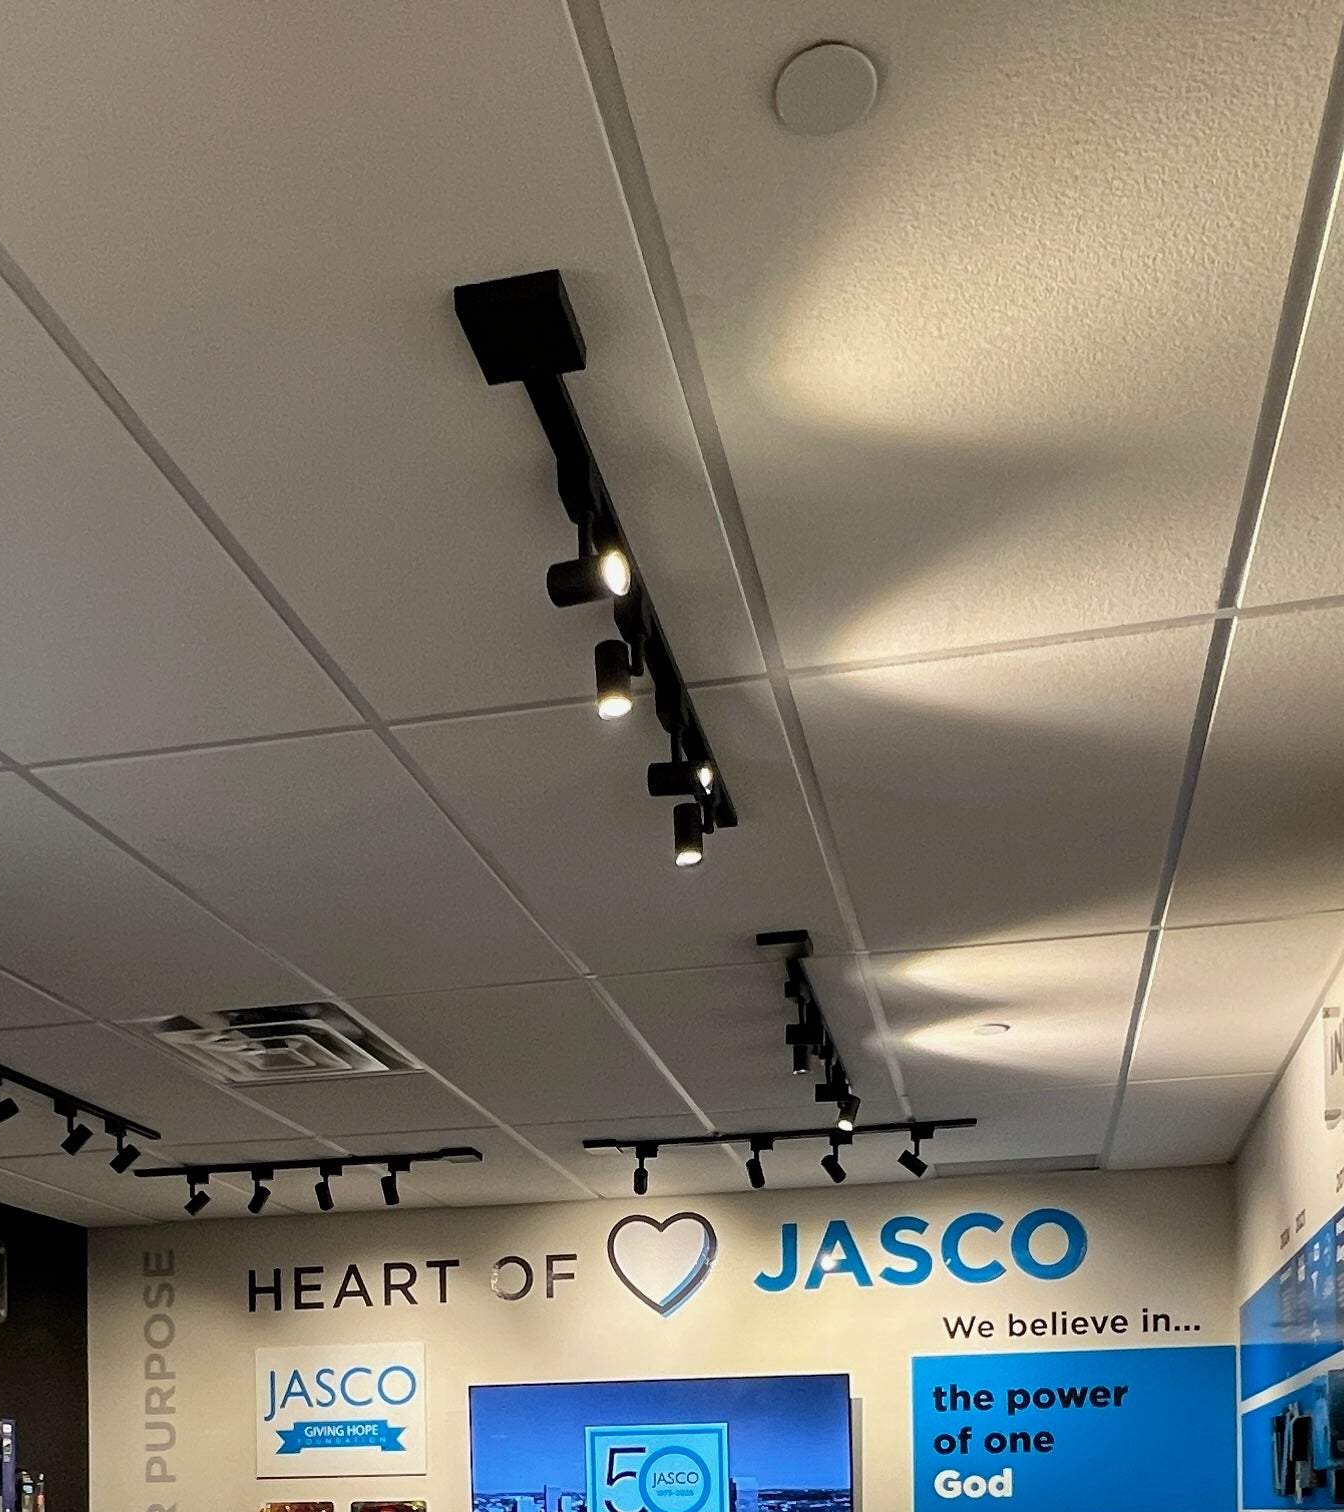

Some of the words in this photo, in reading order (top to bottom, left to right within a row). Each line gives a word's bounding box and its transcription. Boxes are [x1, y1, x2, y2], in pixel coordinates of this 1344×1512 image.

[753, 1207, 1089, 1293] JASCO
[248, 1259, 459, 1313] HEART
[490, 1253, 577, 1301] OF
[943, 1315, 994, 1341] We
[1008, 1308, 1129, 1340] believe
[1141, 1308, 1202, 1334] in...
[144, 1249, 178, 1484] PURPOSE
[264, 1365, 416, 1421] JASCO
[933, 1383, 994, 1413] the
[1007, 1379, 1129, 1416] power
[305, 1425, 344, 1437] GIVING
[347, 1424, 379, 1436] HOPE
[933, 1426, 973, 1455] of
[983, 1427, 1056, 1454] one
[652, 1471, 699, 1488] JASCO
[933, 1467, 1014, 1499] God
